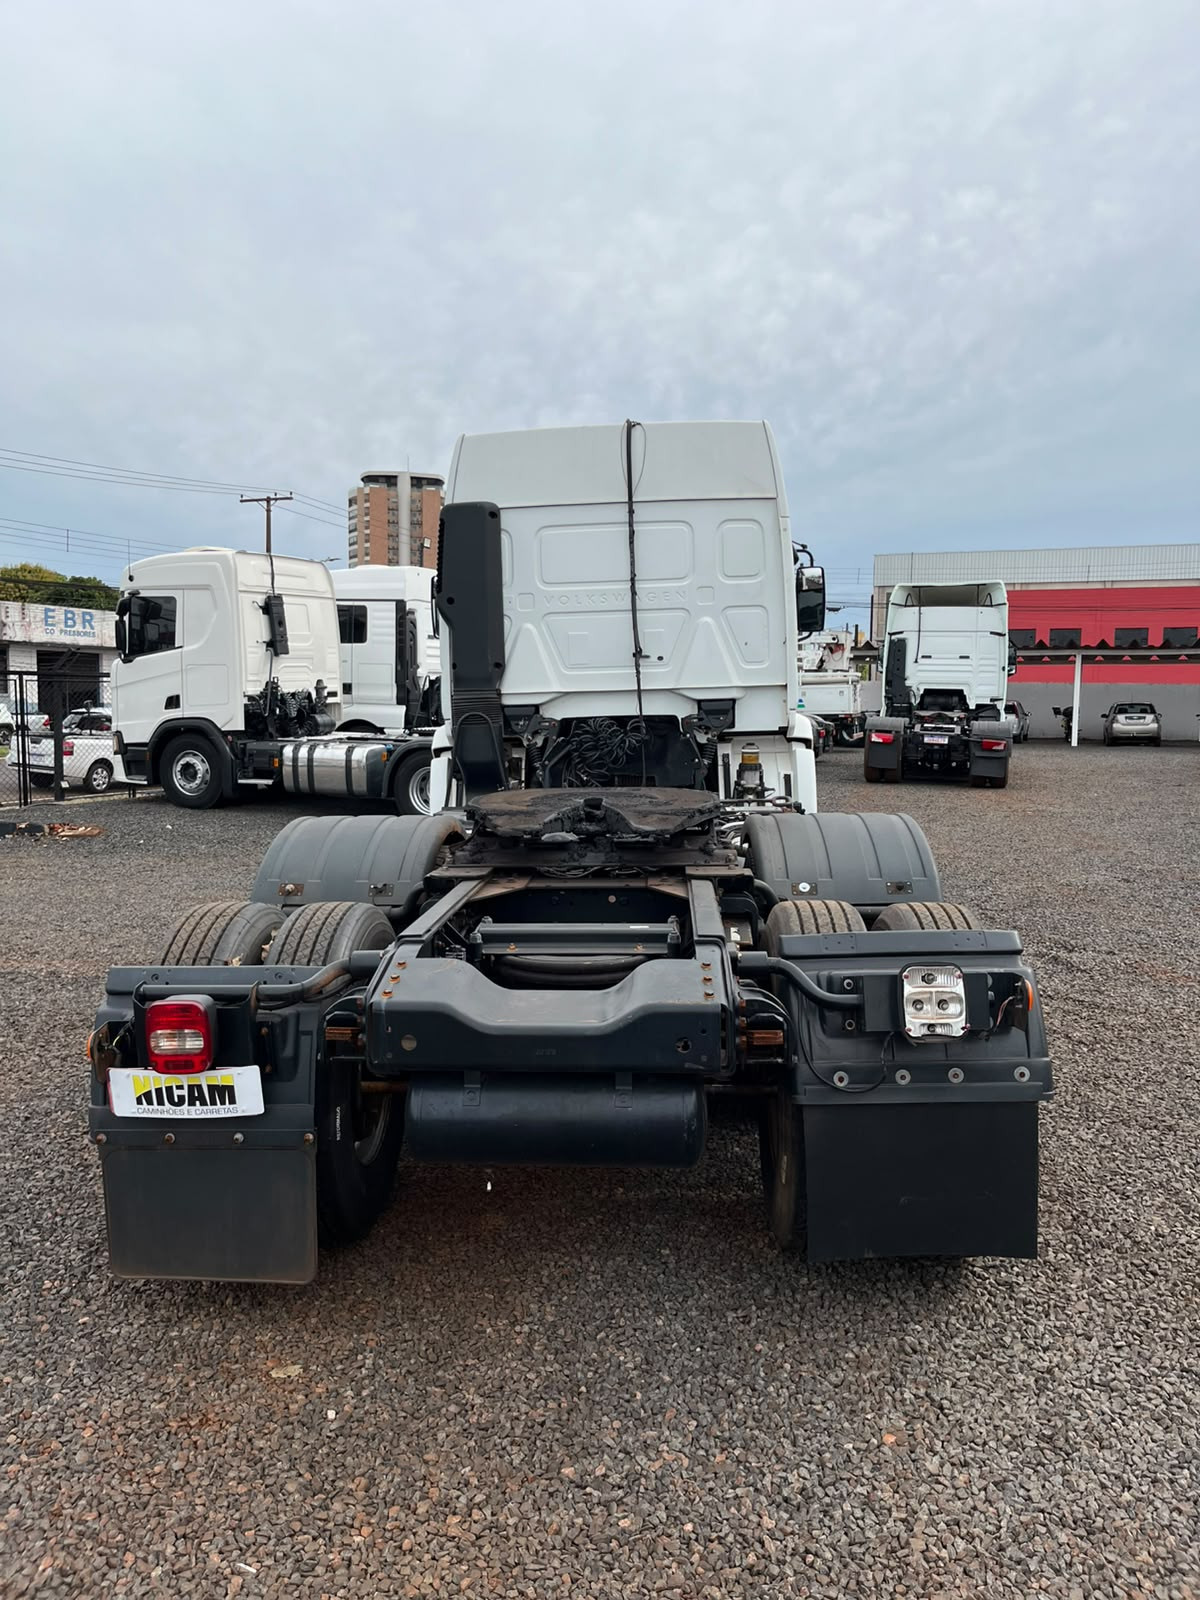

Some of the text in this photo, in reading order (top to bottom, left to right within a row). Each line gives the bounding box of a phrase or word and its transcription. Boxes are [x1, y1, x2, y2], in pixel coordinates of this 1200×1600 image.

[132, 1074, 237, 1107] NICAM
[187, 1108, 192, 1116] E
[195, 1106, 239, 1115] CARRETAS
